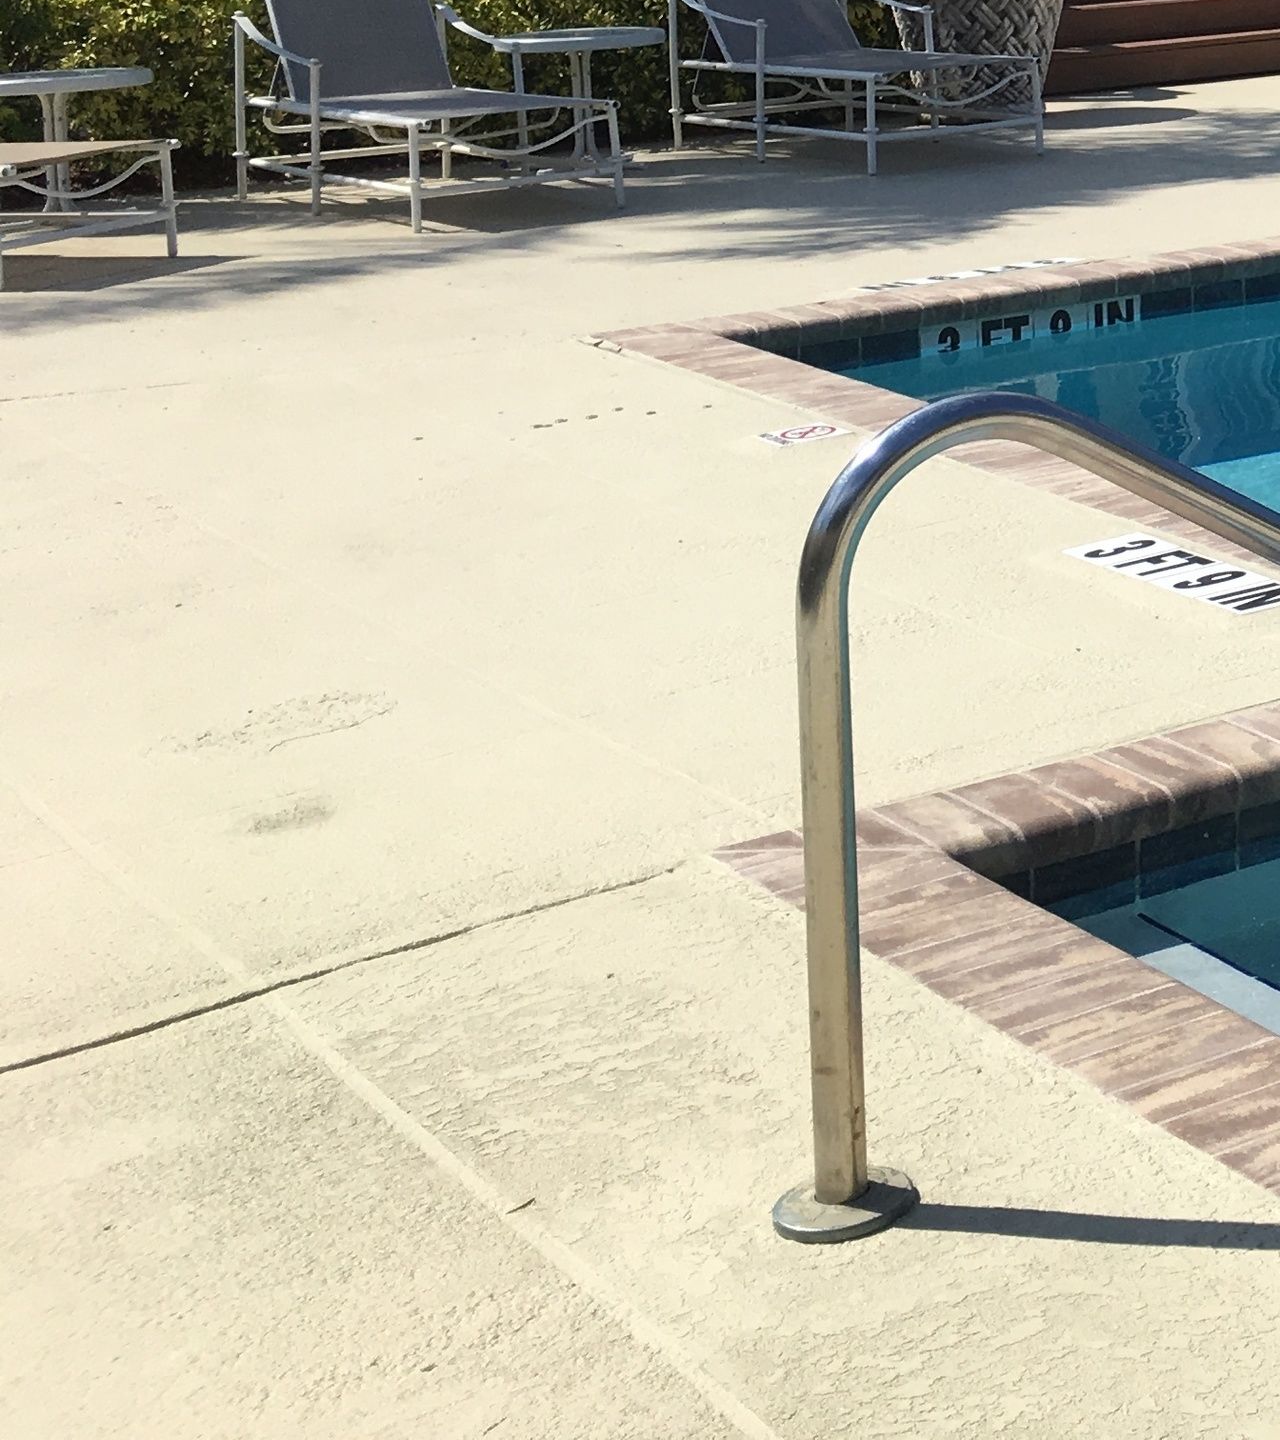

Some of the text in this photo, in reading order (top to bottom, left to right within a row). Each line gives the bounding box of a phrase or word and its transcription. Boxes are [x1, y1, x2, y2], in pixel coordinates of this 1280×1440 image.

[981, 314, 1030, 346] FT
[1093, 298, 1135, 328] IN
[1084, 539, 1156, 558] 3
[1113, 550, 1217, 577] FT
[1173, 570, 1247, 589] 9
